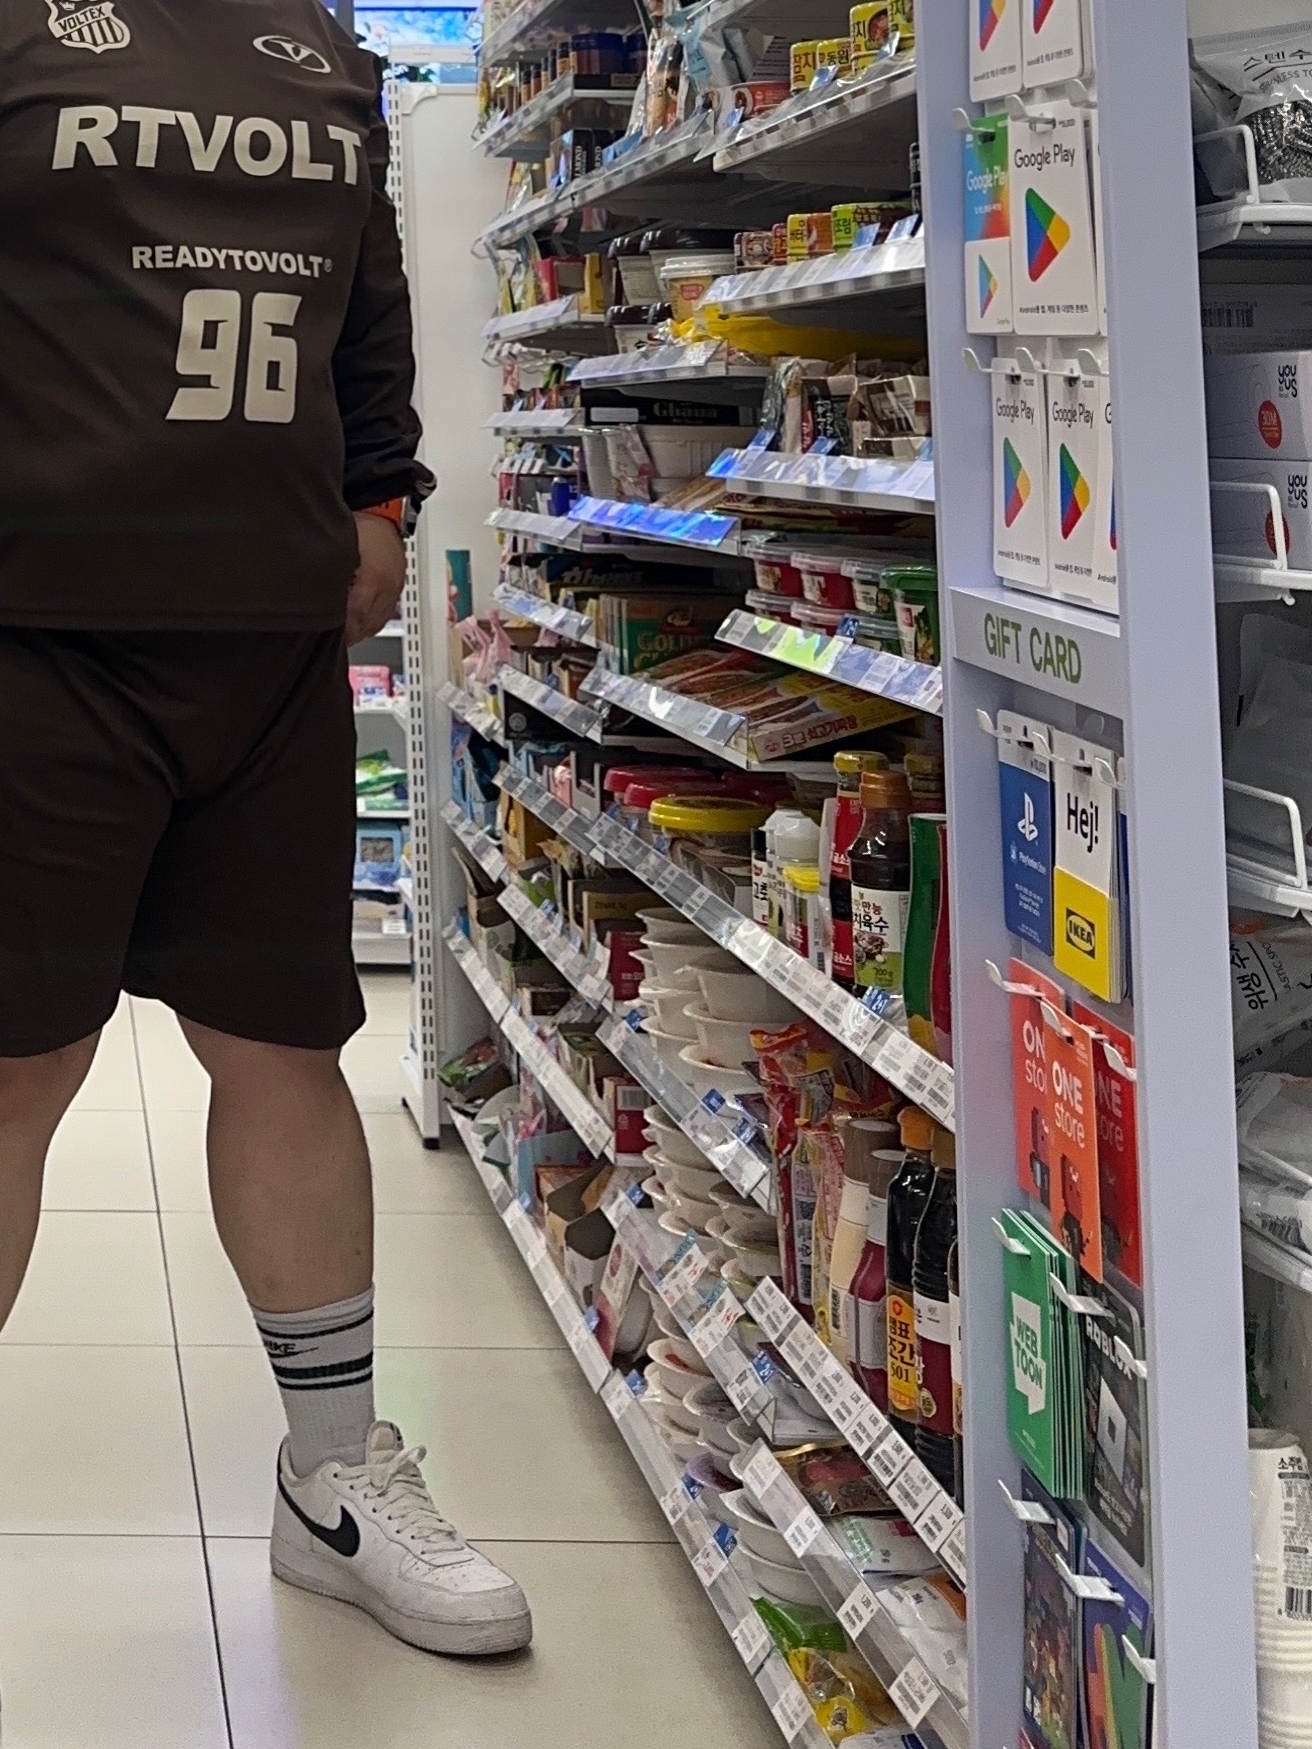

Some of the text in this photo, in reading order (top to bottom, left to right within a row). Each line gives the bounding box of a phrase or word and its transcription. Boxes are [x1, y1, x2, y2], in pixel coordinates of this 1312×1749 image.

[57, 4, 108, 34] VOLTEX
[51, 104, 366, 187] RTVOLT
[1013, 143, 1076, 171] Google Play
[966, 169, 993, 194] Google
[166, 289, 302, 424] 96
[996, 398, 1035, 425] Google Play
[1052, 401, 1094, 429] Google Play
[983, 612, 1082, 684] GIFT CARD
[1066, 792, 1099, 854] Hej!
[1068, 918, 1094, 947] IKEA
[1052, 1060, 1084, 1116] ONE
[1054, 1101, 1086, 1149] store
[1015, 1315, 1038, 1353] WEB
[1014, 1339, 1043, 1391] TOON
